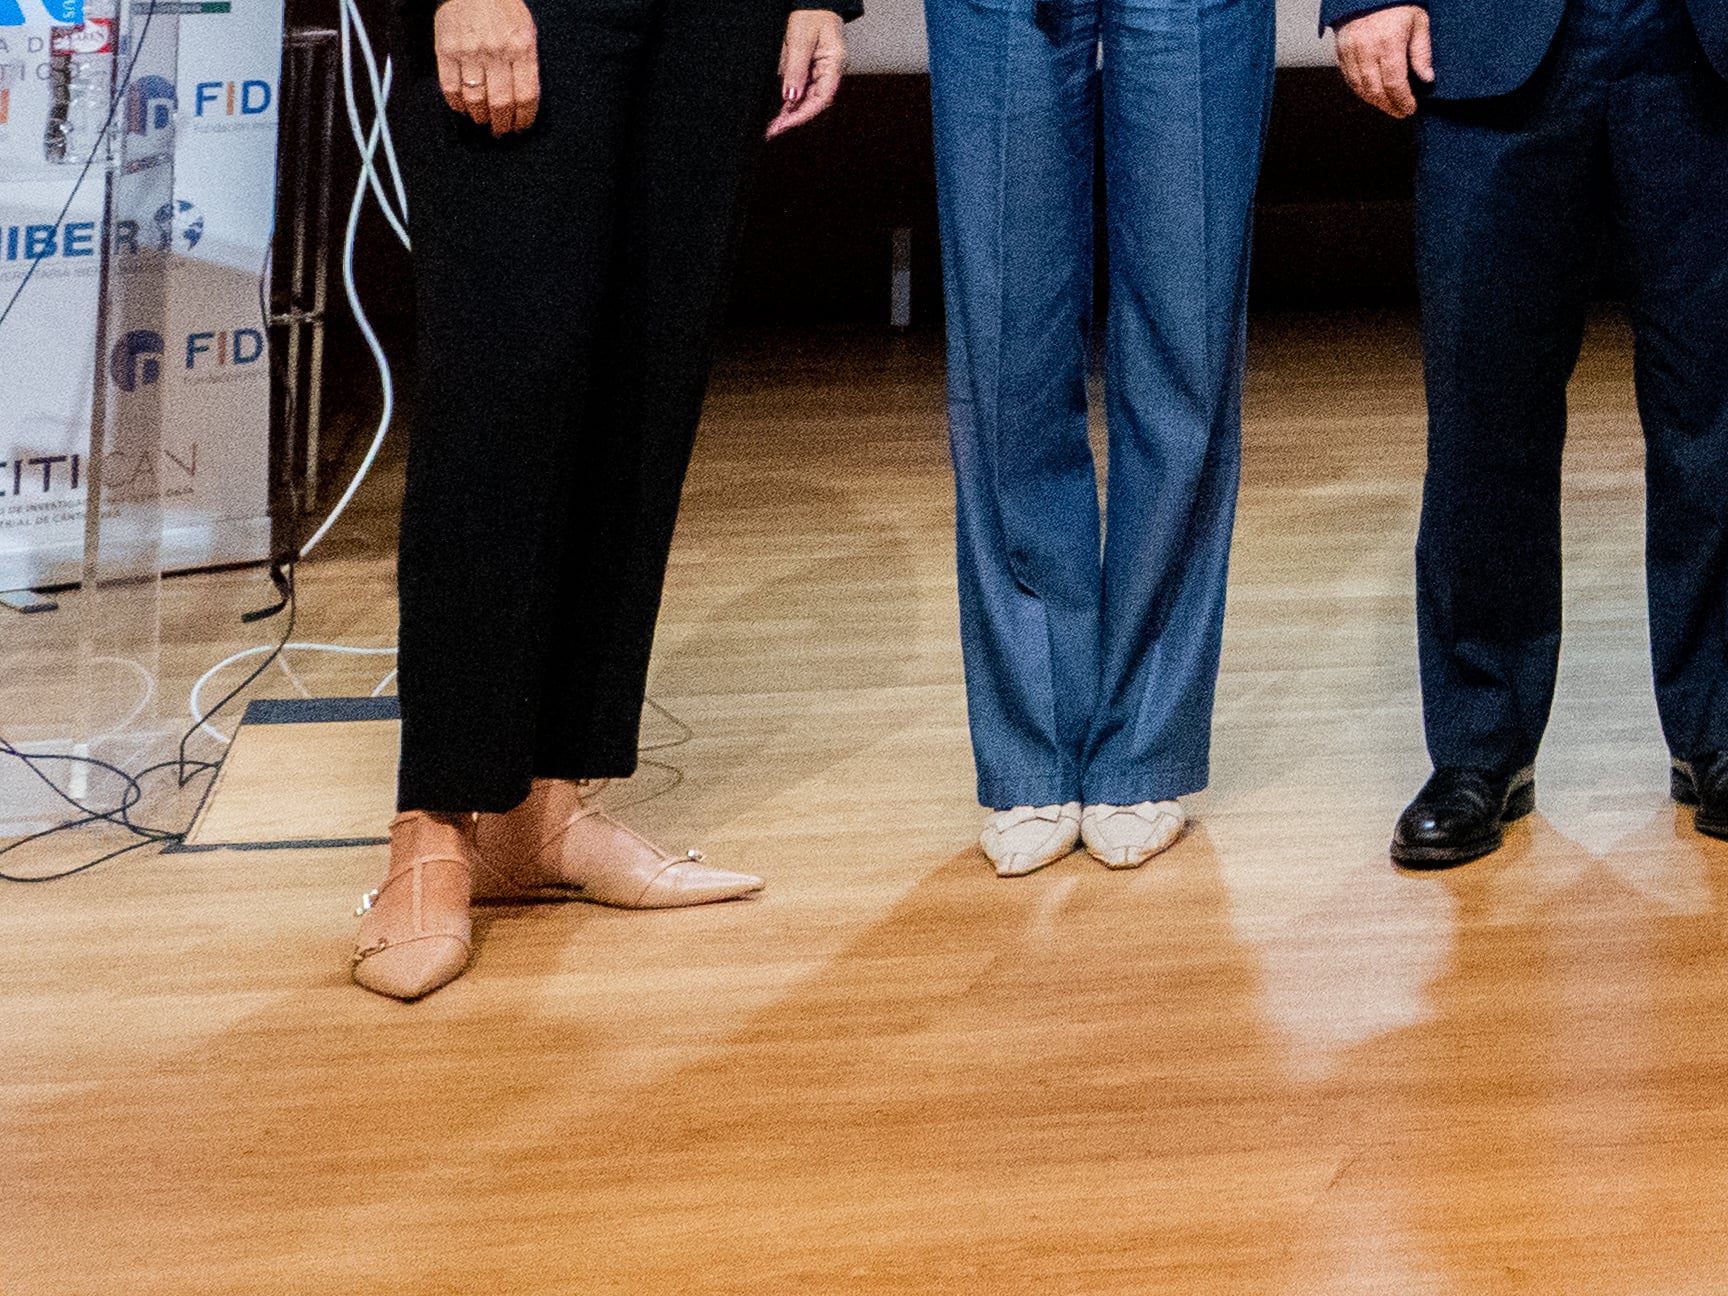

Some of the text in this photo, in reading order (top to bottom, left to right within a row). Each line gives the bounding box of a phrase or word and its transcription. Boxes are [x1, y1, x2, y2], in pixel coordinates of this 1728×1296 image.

[195, 80, 272, 117] FID
[0, 220, 139, 261] IBER
[185, 328, 263, 369] FID
